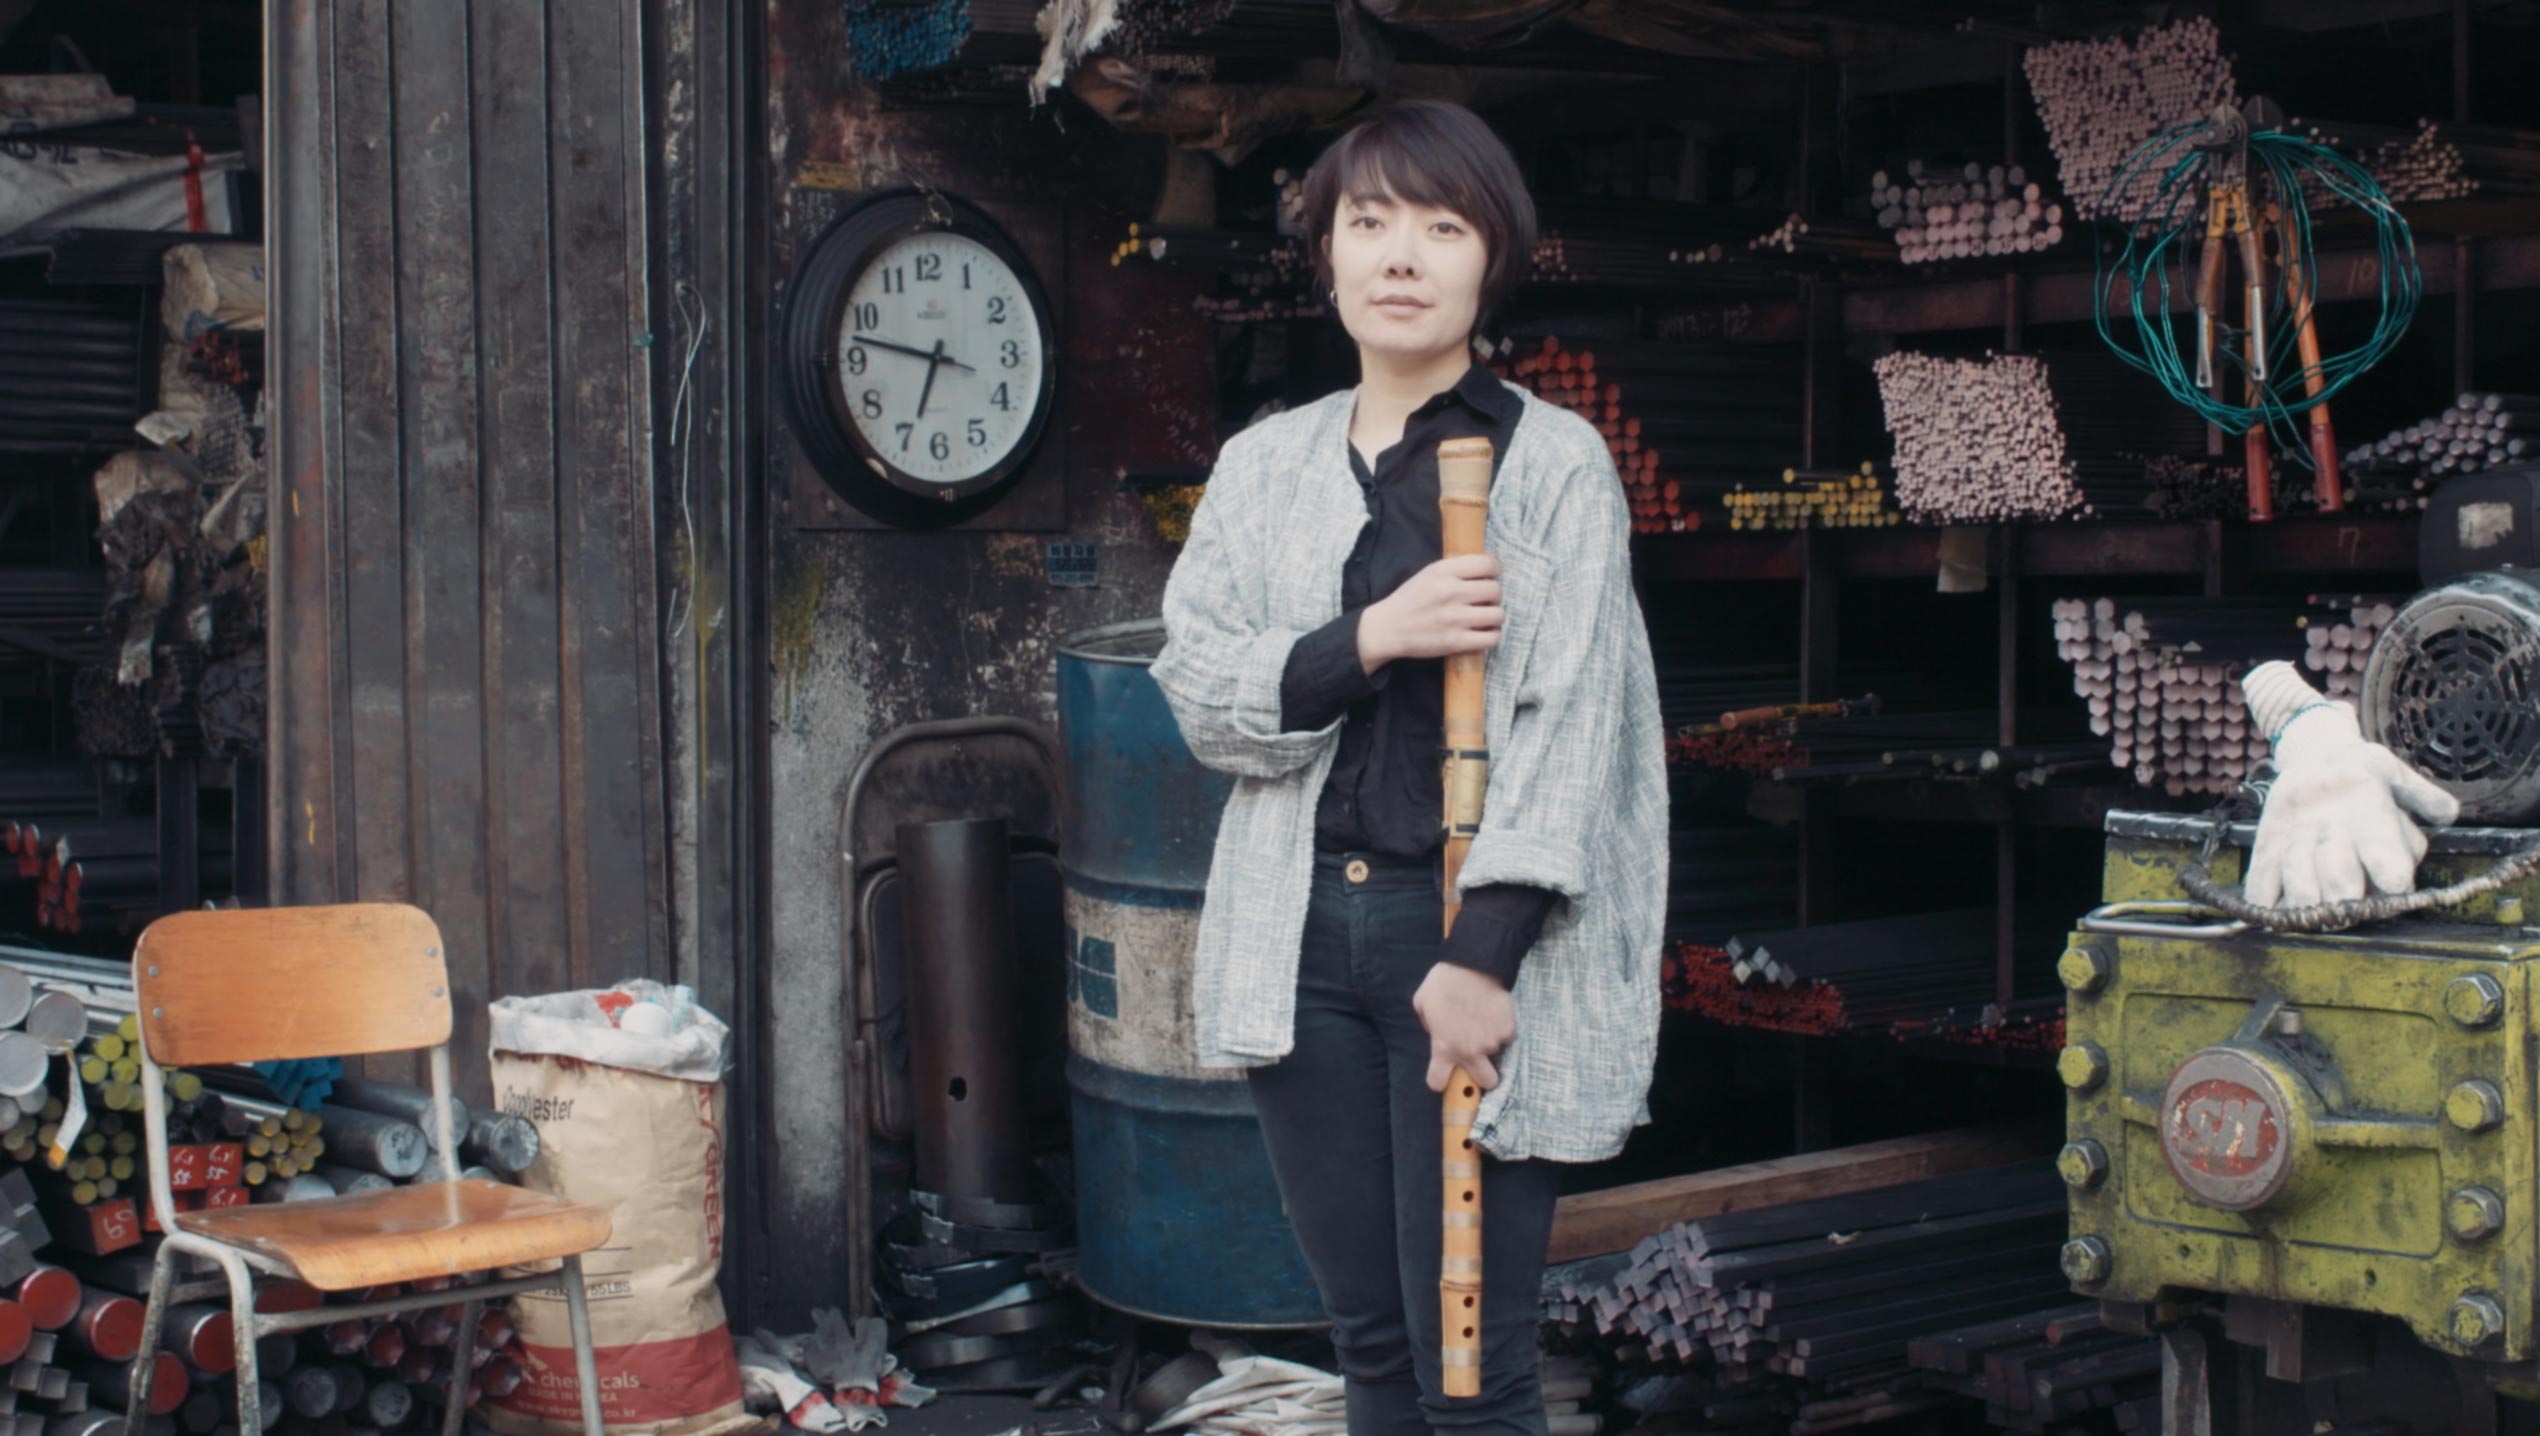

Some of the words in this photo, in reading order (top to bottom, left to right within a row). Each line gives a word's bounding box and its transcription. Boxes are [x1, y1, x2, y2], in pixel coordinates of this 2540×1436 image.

[882, 267, 904, 294] 11
[915, 253, 941, 281] 12
[961, 264, 972, 289] 1
[855, 303, 878, 330] 10
[987, 297, 1006, 324] 2
[848, 347, 866, 375] 9
[1001, 341, 1019, 368] 3
[864, 390, 882, 418] 8
[991, 382, 1009, 411] 4
[896, 423, 913, 451] 7
[930, 433, 949, 460] 6
[967, 420, 986, 446] 5
[540, 1370, 640, 1389] checals
[560, 1390, 574, 1401] IN
